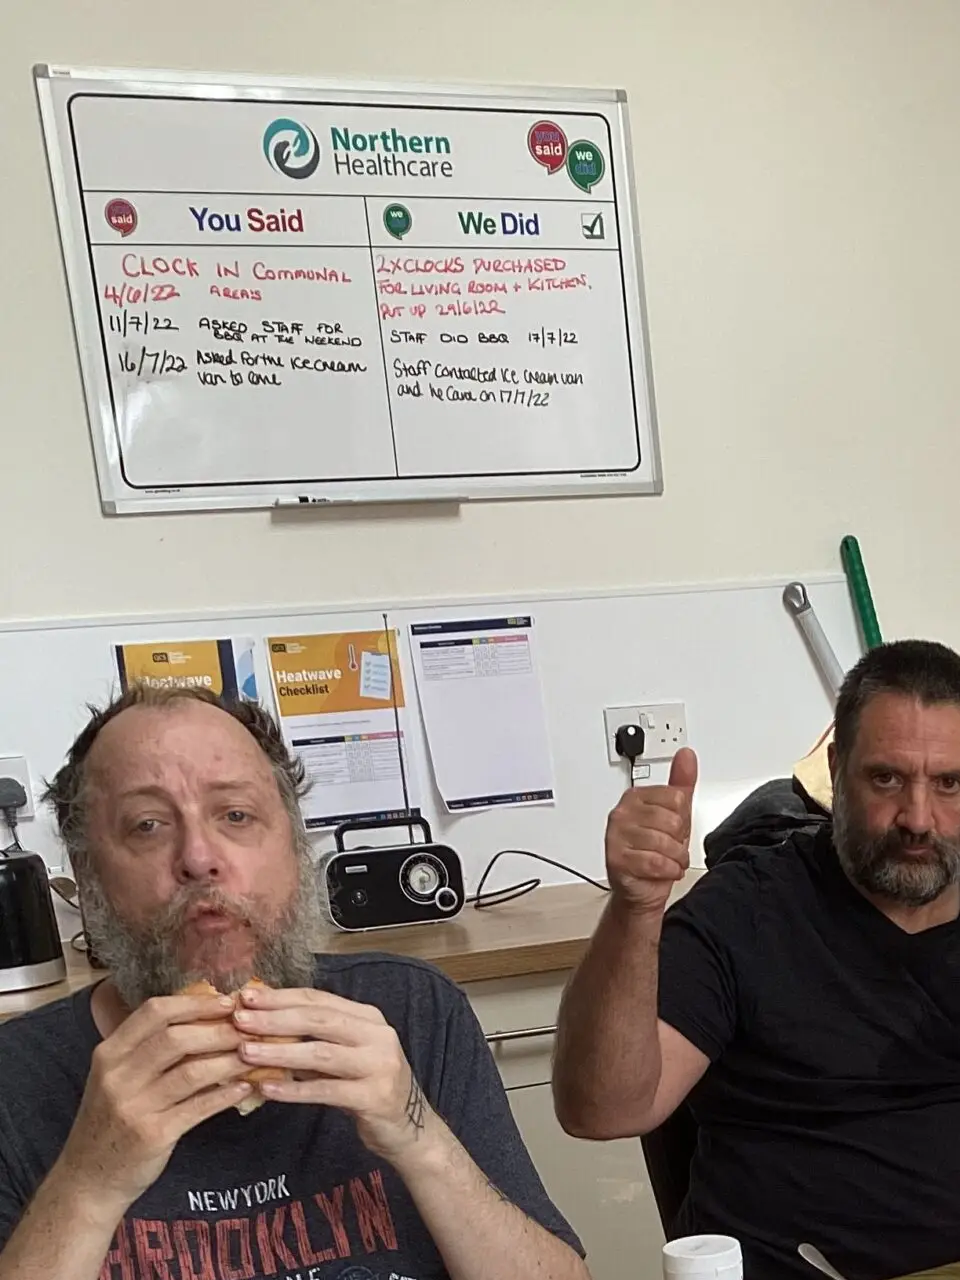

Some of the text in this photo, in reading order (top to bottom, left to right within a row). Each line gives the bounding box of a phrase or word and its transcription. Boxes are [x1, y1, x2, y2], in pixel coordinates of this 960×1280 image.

[331, 127, 452, 154] Northern
[535, 143, 563, 156] said
[575, 151, 594, 161] we
[334, 153, 453, 178] Healthcare
[110, 214, 134, 225] said
[189, 206, 304, 232] You Said
[458, 211, 540, 235] We Did
[122, 253, 200, 278] CLOCK
[216, 260, 240, 278] IN
[472, 257, 567, 275] PURCHASED
[377, 279, 407, 295] FOR
[411, 282, 461, 296] LIVING
[467, 280, 507, 294] ROOM
[410, 306, 427, 319] UP
[109, 309, 180, 338] 11/7/22
[199, 317, 344, 335] ASKED STAFF FOR
[213, 329, 245, 342] BBQ
[251, 333, 269, 343] AT
[304, 335, 363, 348] WEEKEND
[390, 326, 579, 348] STAFF DID BBQ 17/7/22
[118, 346, 188, 376] 16/7/22
[197, 349, 237, 366] Asked
[229, 369, 244, 386] to
[393, 358, 432, 379] Staff
[396, 380, 423, 397] and
[428, 382, 444, 402] he
[276, 668, 342, 683] Heatwave
[279, 684, 329, 697] Checklist
